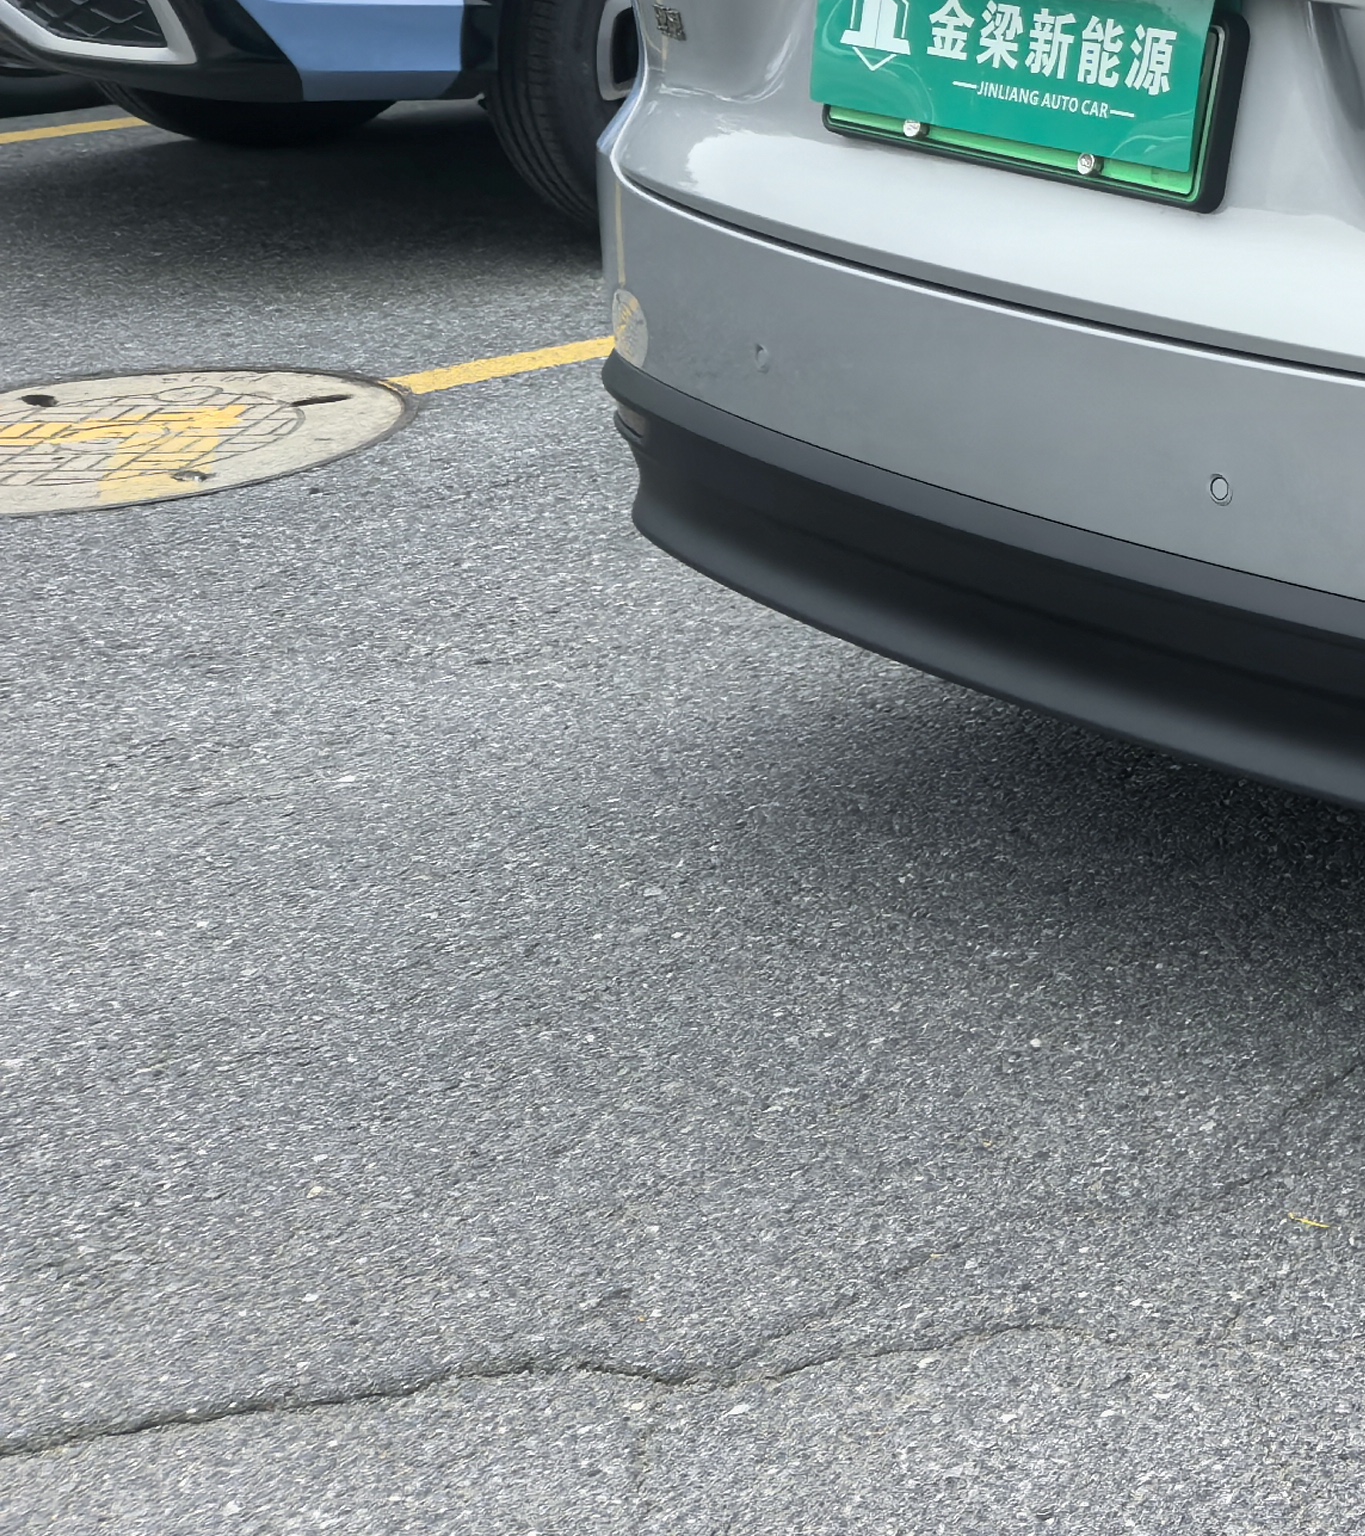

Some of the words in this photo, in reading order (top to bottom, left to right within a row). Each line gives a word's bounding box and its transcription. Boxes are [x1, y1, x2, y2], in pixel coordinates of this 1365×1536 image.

[977, 80, 1040, 106] JINLIANG
[1041, 93, 1079, 113] AUTO
[1081, 99, 1109, 118] CAR
